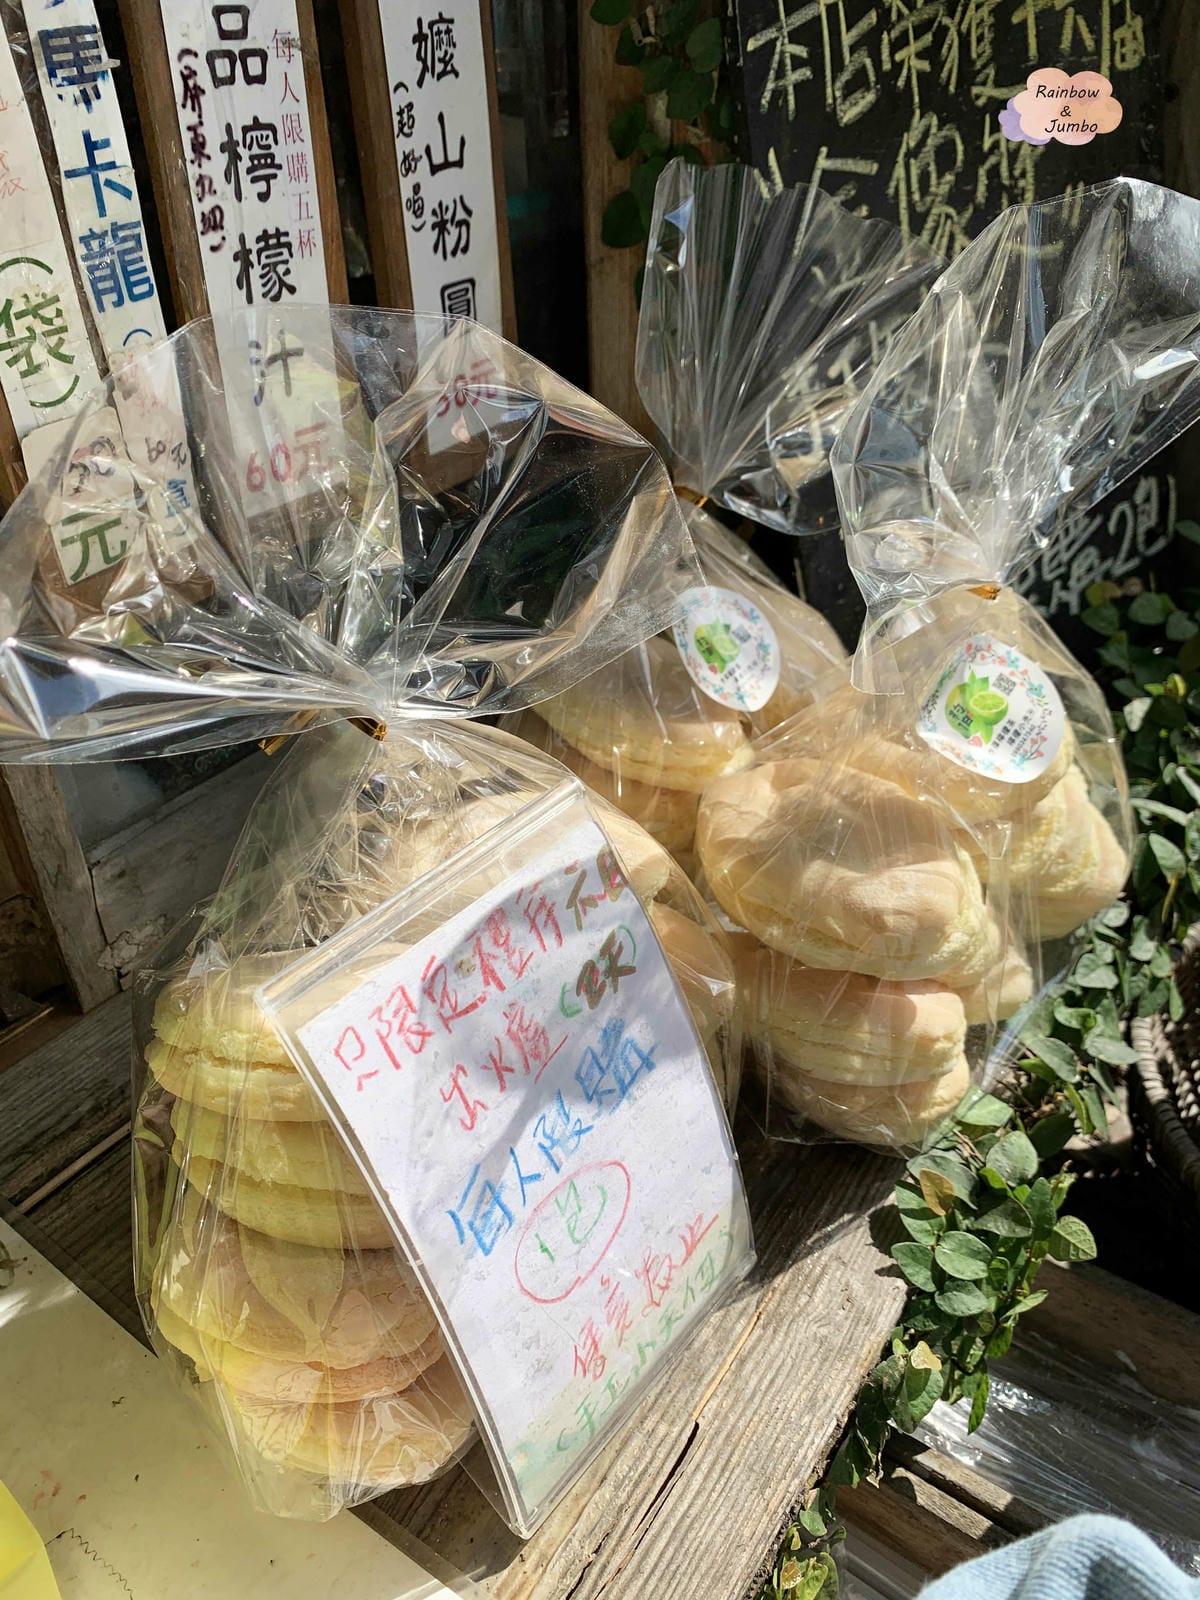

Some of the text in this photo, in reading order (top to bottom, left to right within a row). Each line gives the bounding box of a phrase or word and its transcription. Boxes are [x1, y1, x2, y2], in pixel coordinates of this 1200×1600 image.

[271, 28, 317, 260] 每人限購五杯
[245, 421, 331, 493] 60元
[446, 1016, 657, 1257] 每人限購
